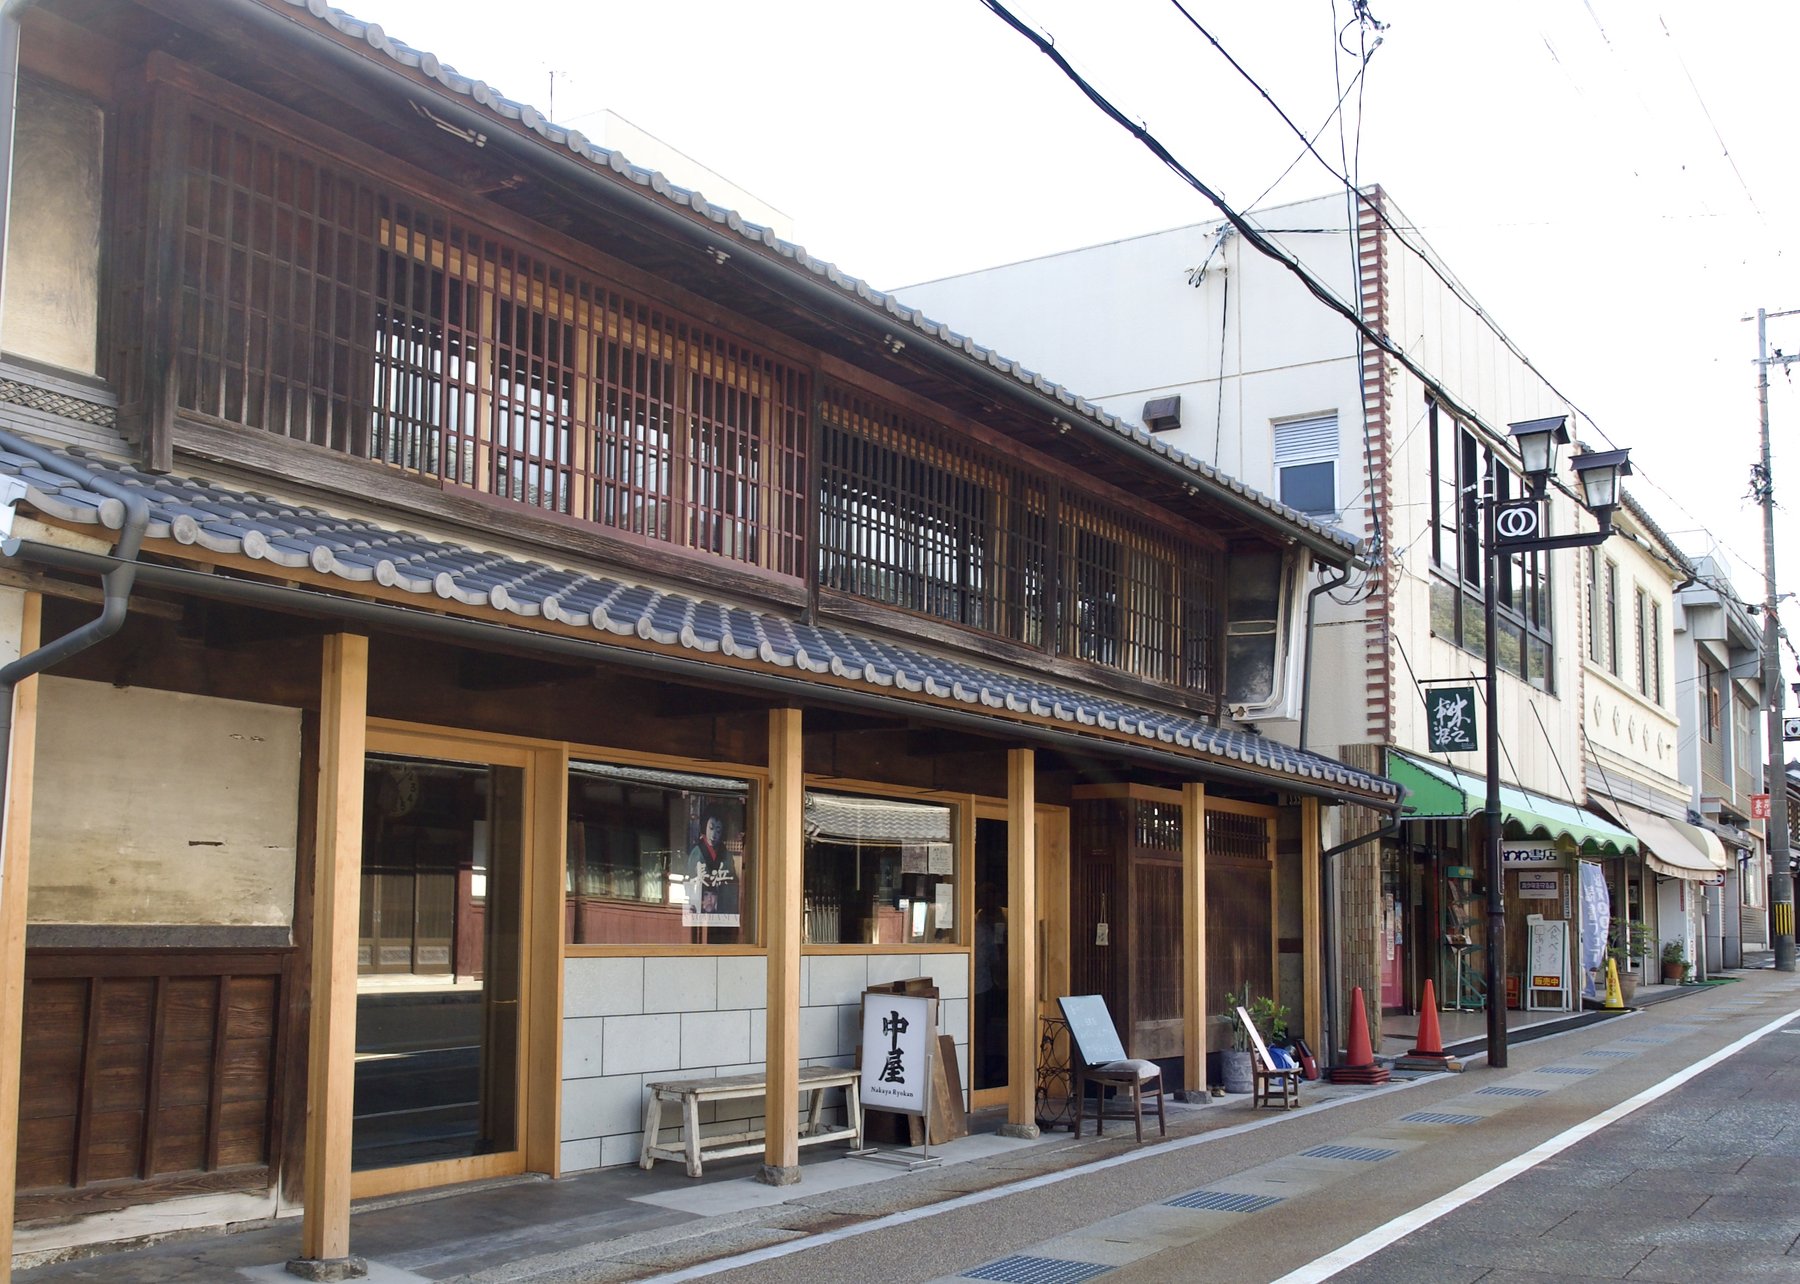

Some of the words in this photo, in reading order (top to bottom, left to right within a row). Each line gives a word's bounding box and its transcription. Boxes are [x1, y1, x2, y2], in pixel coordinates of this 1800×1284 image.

[1503, 848, 1557, 861] わね書店
[689, 861, 734, 887] 長浜
[1534, 976, 1559, 986] 販売中
[878, 1010, 910, 1084] 中屋
[871, 1086, 892, 1096] Nakaya
[892, 1088, 914, 1097] Ryokan
